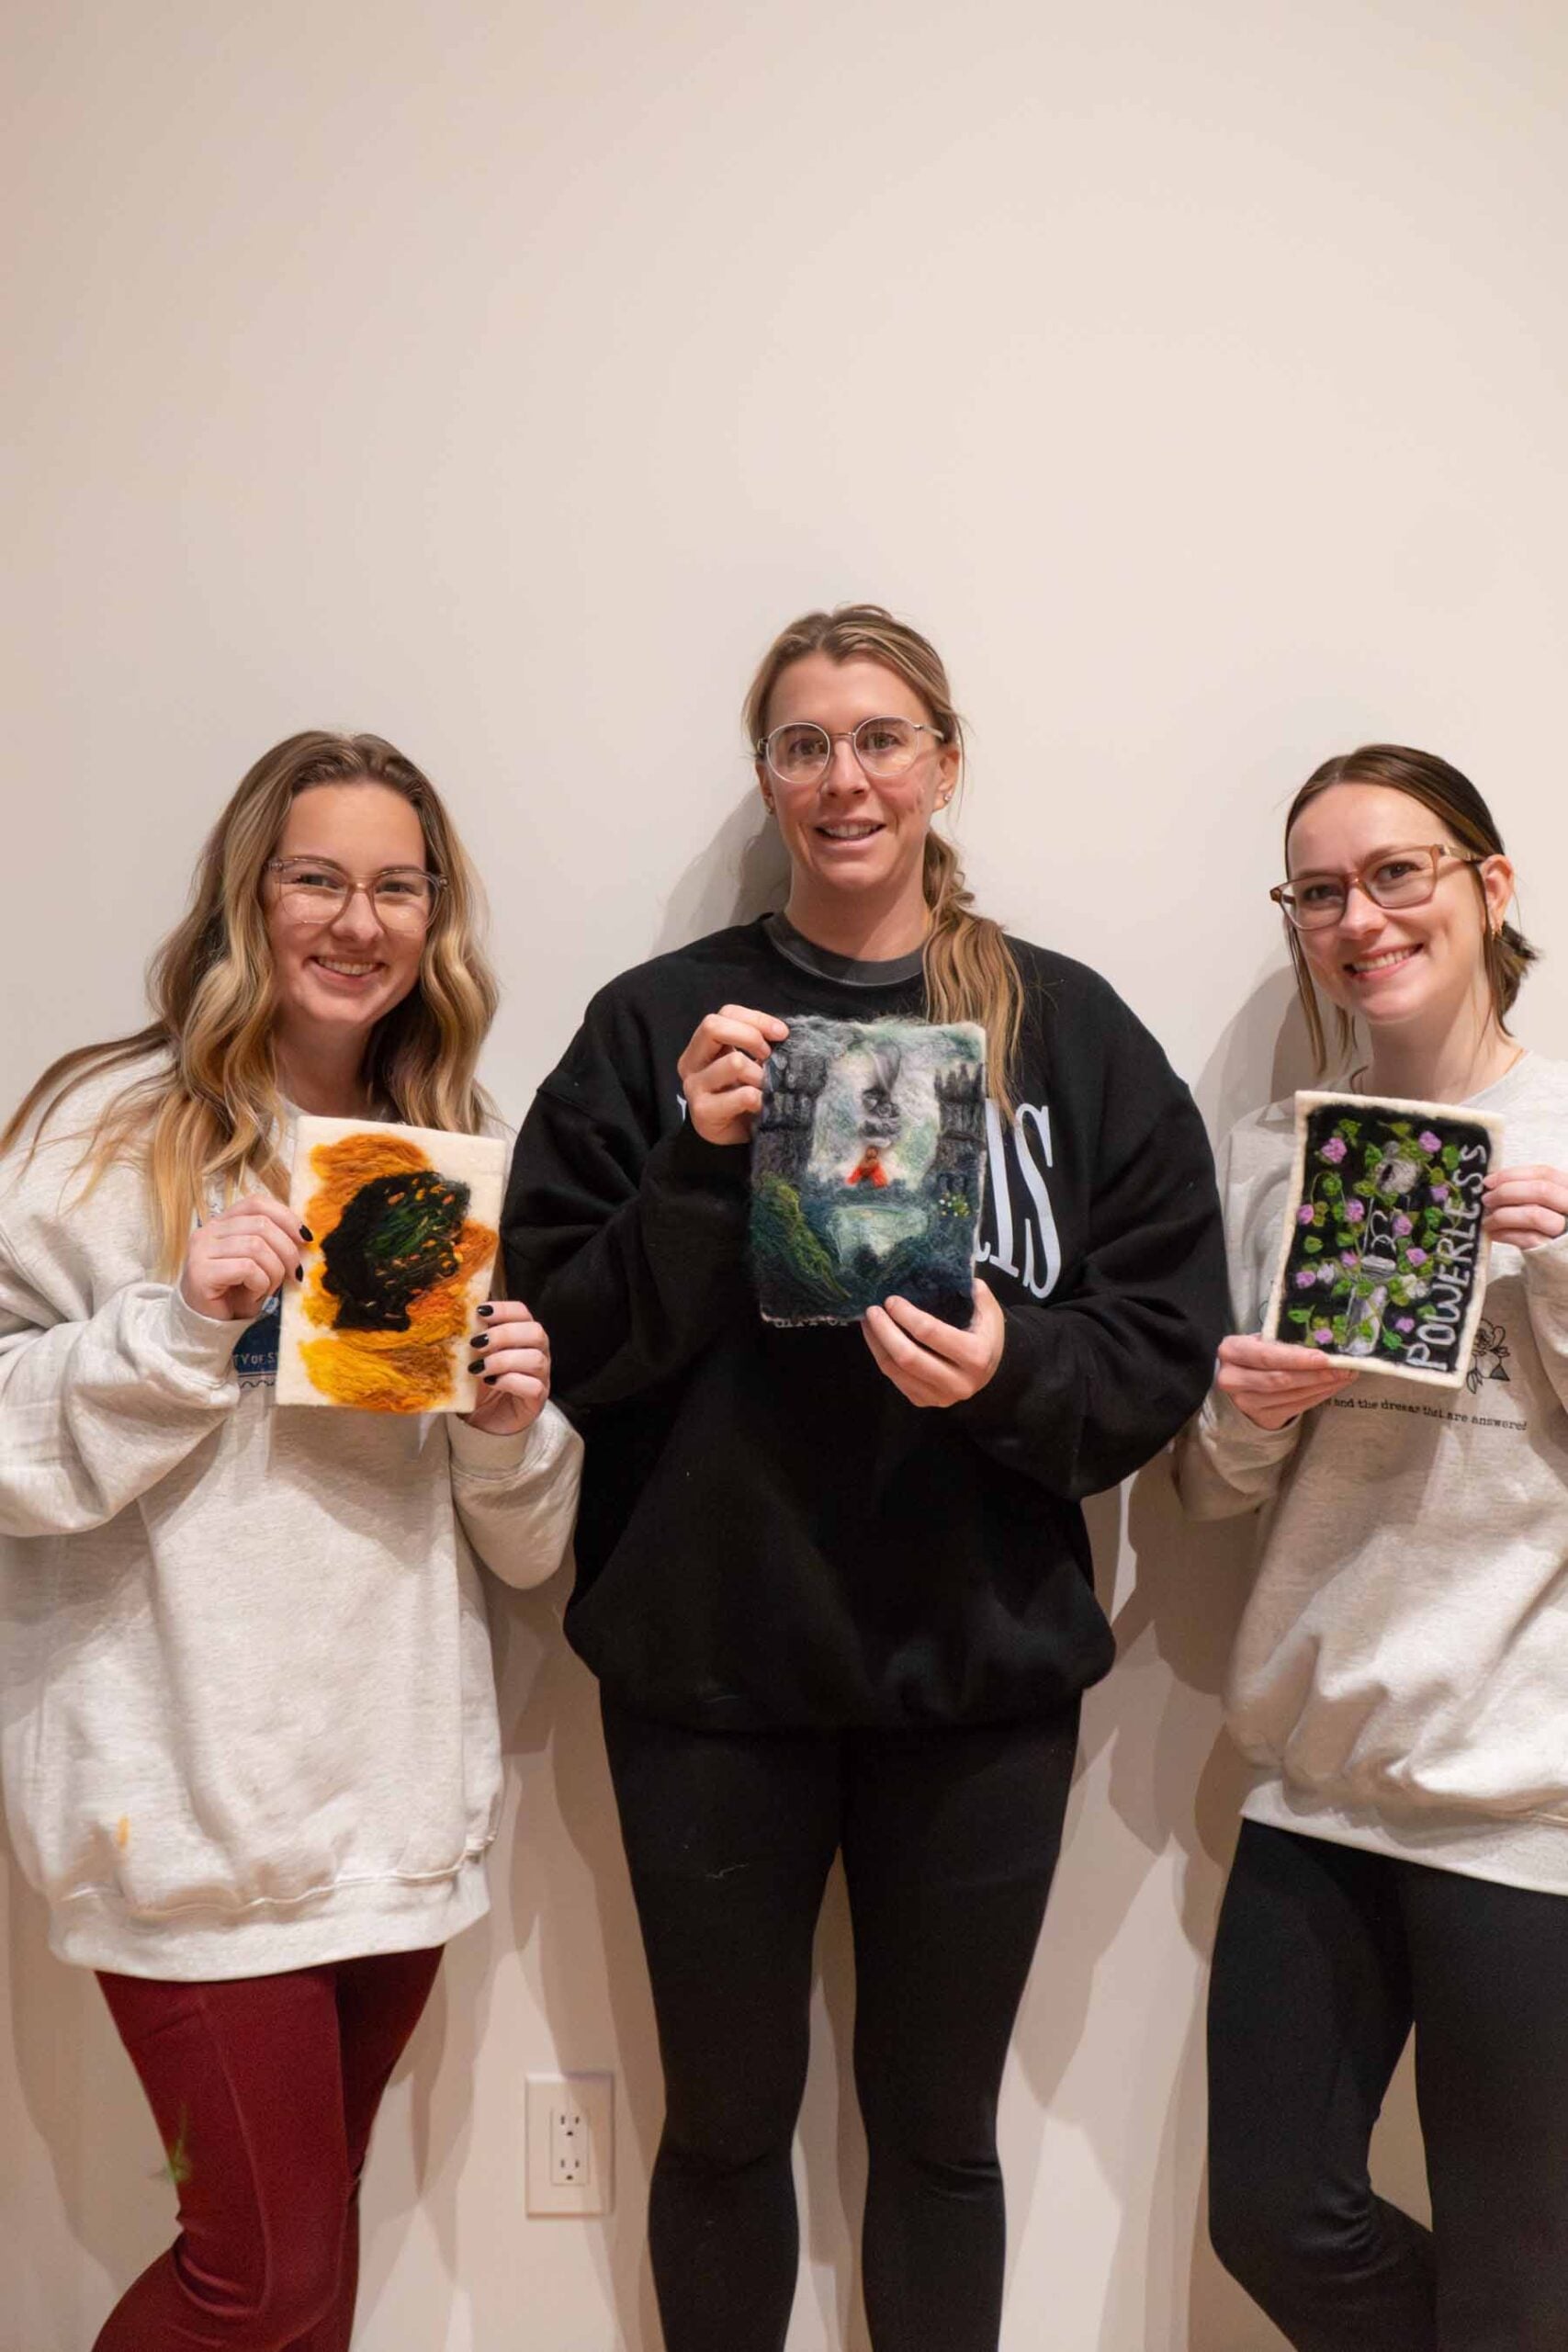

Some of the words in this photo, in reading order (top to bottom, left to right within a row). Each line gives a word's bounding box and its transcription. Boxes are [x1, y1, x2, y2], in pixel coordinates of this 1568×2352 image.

[1405, 1145, 1486, 1371] POWERLESS
[1335, 1398, 1354, 1408] and
[1359, 1399, 1378, 1410] the
[1447, 1411, 1469, 1422] are
